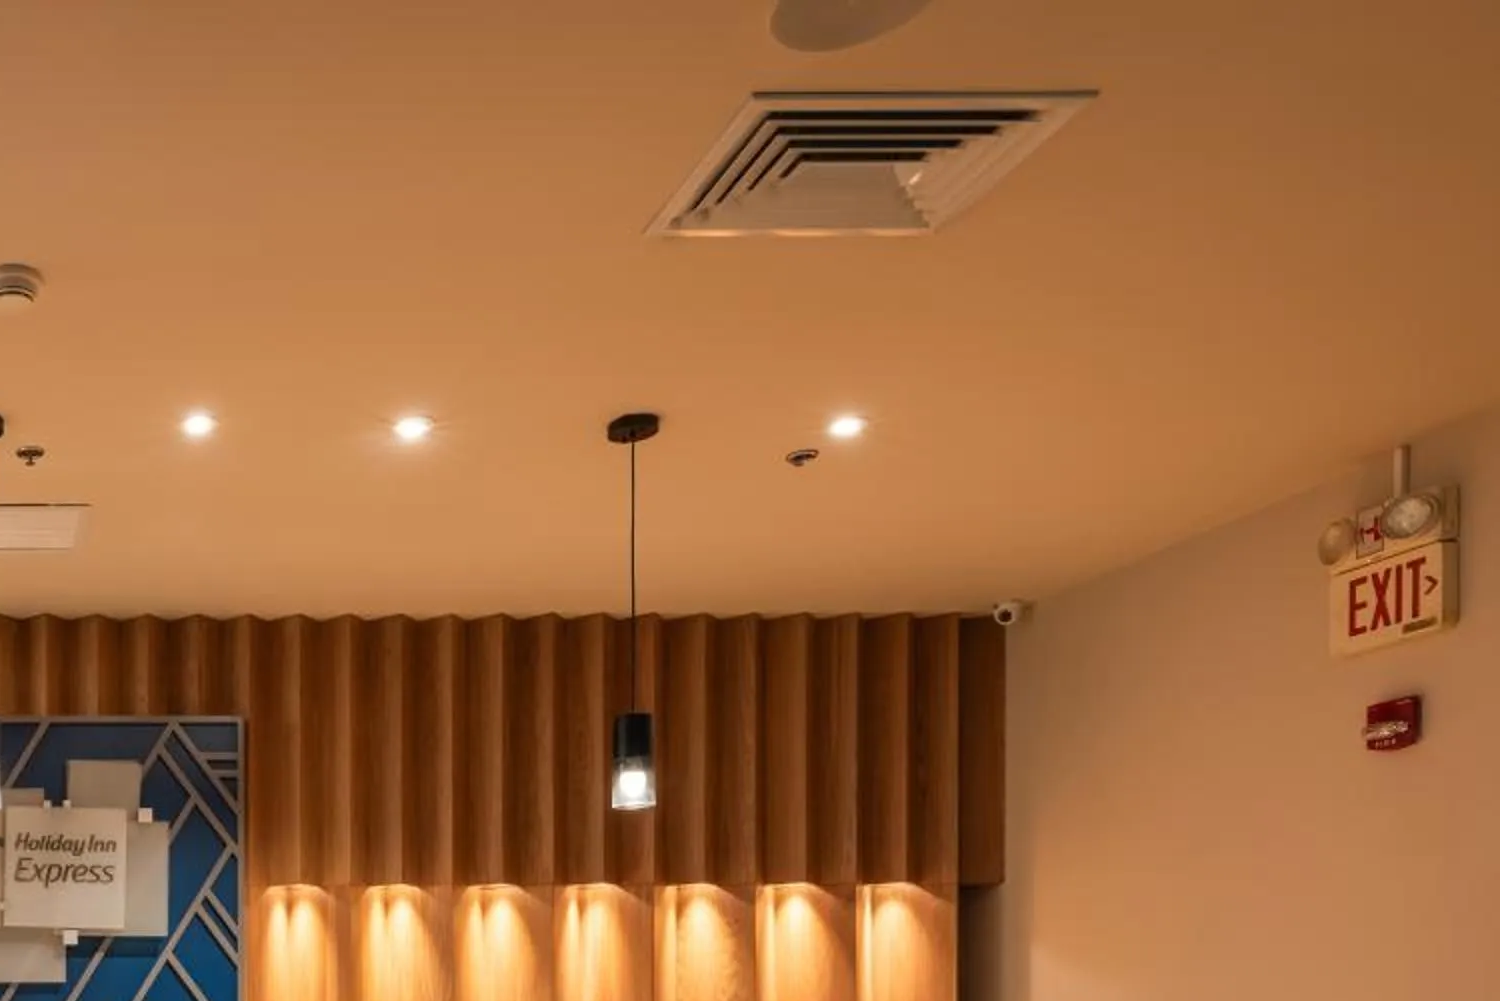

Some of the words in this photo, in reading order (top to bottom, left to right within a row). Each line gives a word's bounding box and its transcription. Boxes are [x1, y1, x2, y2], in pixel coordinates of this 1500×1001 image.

[1348, 556, 1426, 636] EXIT
[14, 832, 85, 857] Holiday
[87, 834, 117, 852] Inn
[14, 857, 115, 888] Express
